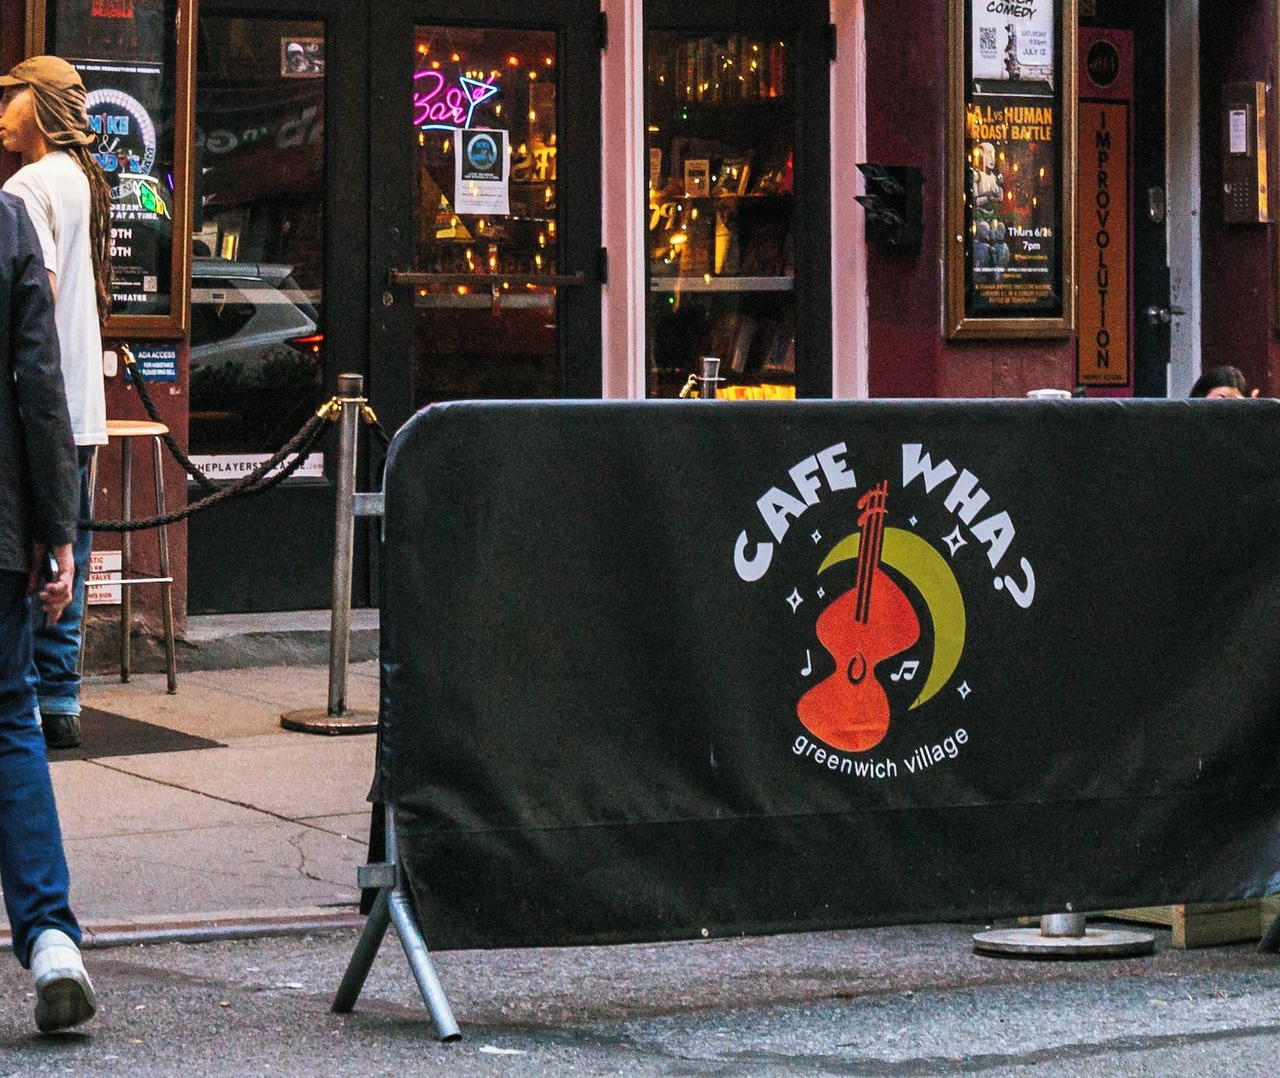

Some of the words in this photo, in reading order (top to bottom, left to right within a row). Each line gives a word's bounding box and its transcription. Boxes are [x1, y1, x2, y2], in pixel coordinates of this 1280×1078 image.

[986, 1, 1038, 20] COMEDY
[414, 71, 467, 126] Bar
[1004, 106, 1053, 125] HUMAN
[972, 123, 1009, 140] ROAST
[1011, 125, 1052, 141] BATTLE
[1007, 226, 1034, 237] Thurs
[1095, 110, 1111, 369] IMPROVOLUTION
[1022, 240, 1041, 252] 7pm
[113, 293, 148, 302] THEATRE
[138, 351, 151, 359] ADA
[152, 351, 176, 359] ACCESS
[733, 441, 857, 583] CAFE
[901, 442, 1036, 609] WHA?
[790, 733, 898, 779] greenwich
[904, 726, 969, 775] village
